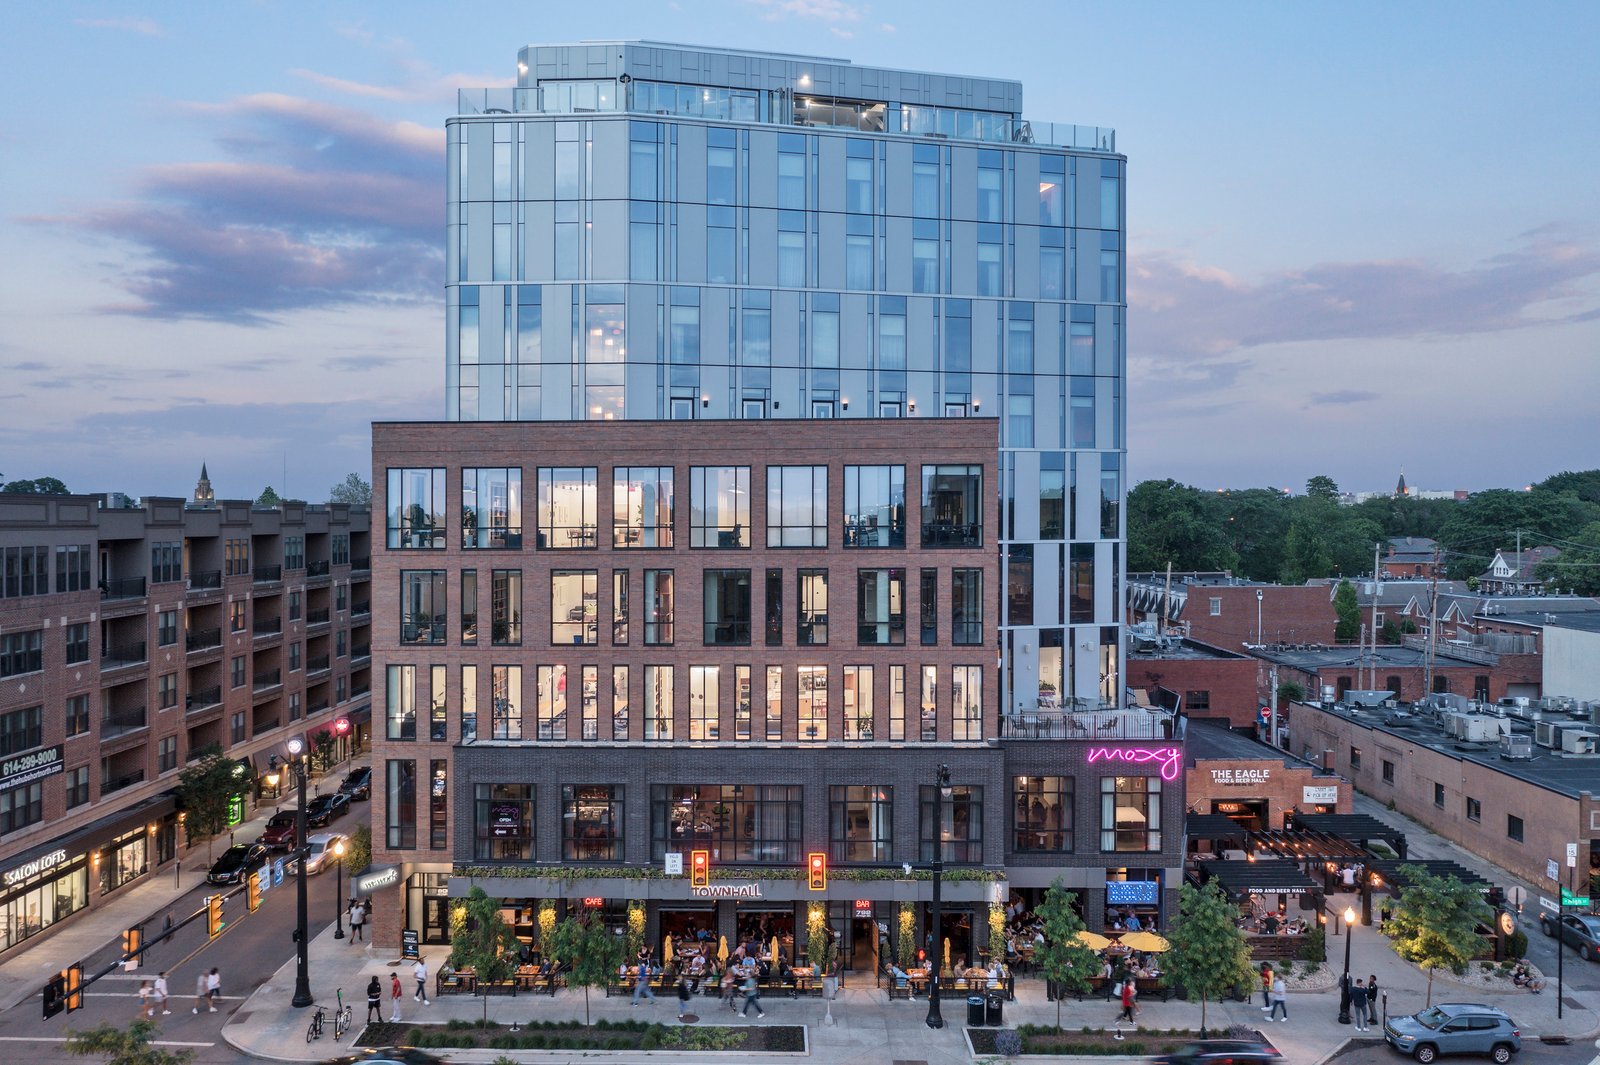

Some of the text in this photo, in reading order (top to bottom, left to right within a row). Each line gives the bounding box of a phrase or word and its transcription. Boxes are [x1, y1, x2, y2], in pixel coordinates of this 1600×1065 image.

[3, 748, 57, 776] 614-299-9000
[1088, 748, 1180, 780] moxy
[1211, 769, 1270, 778] THE EAGLE
[5, 849, 67, 885] SALON LOFTS
[691, 884, 762, 898] TOWNHALL
[856, 900, 870, 908] BAR
